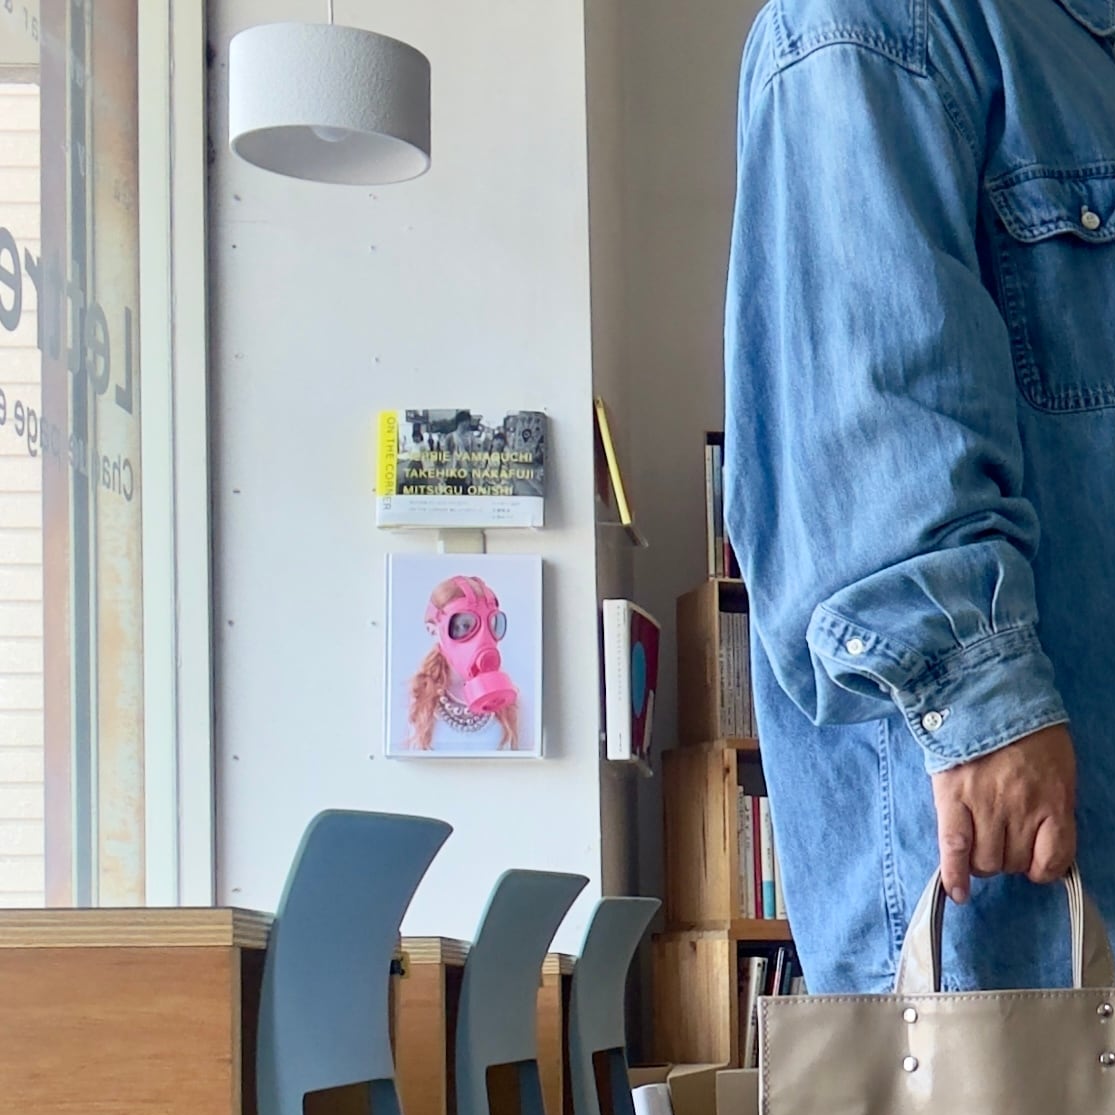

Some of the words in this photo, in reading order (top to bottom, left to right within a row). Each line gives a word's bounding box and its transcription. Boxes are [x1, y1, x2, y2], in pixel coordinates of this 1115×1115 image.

[455, 451, 533, 462] YAMAGUCHI
[404, 469, 468, 479] TAKEHIKO
[472, 469, 534, 479] NAKAFUJI
[382, 462, 396, 511] CORNER
[402, 486, 463, 495] MITSUGU
[467, 485, 514, 496] ONISHI
